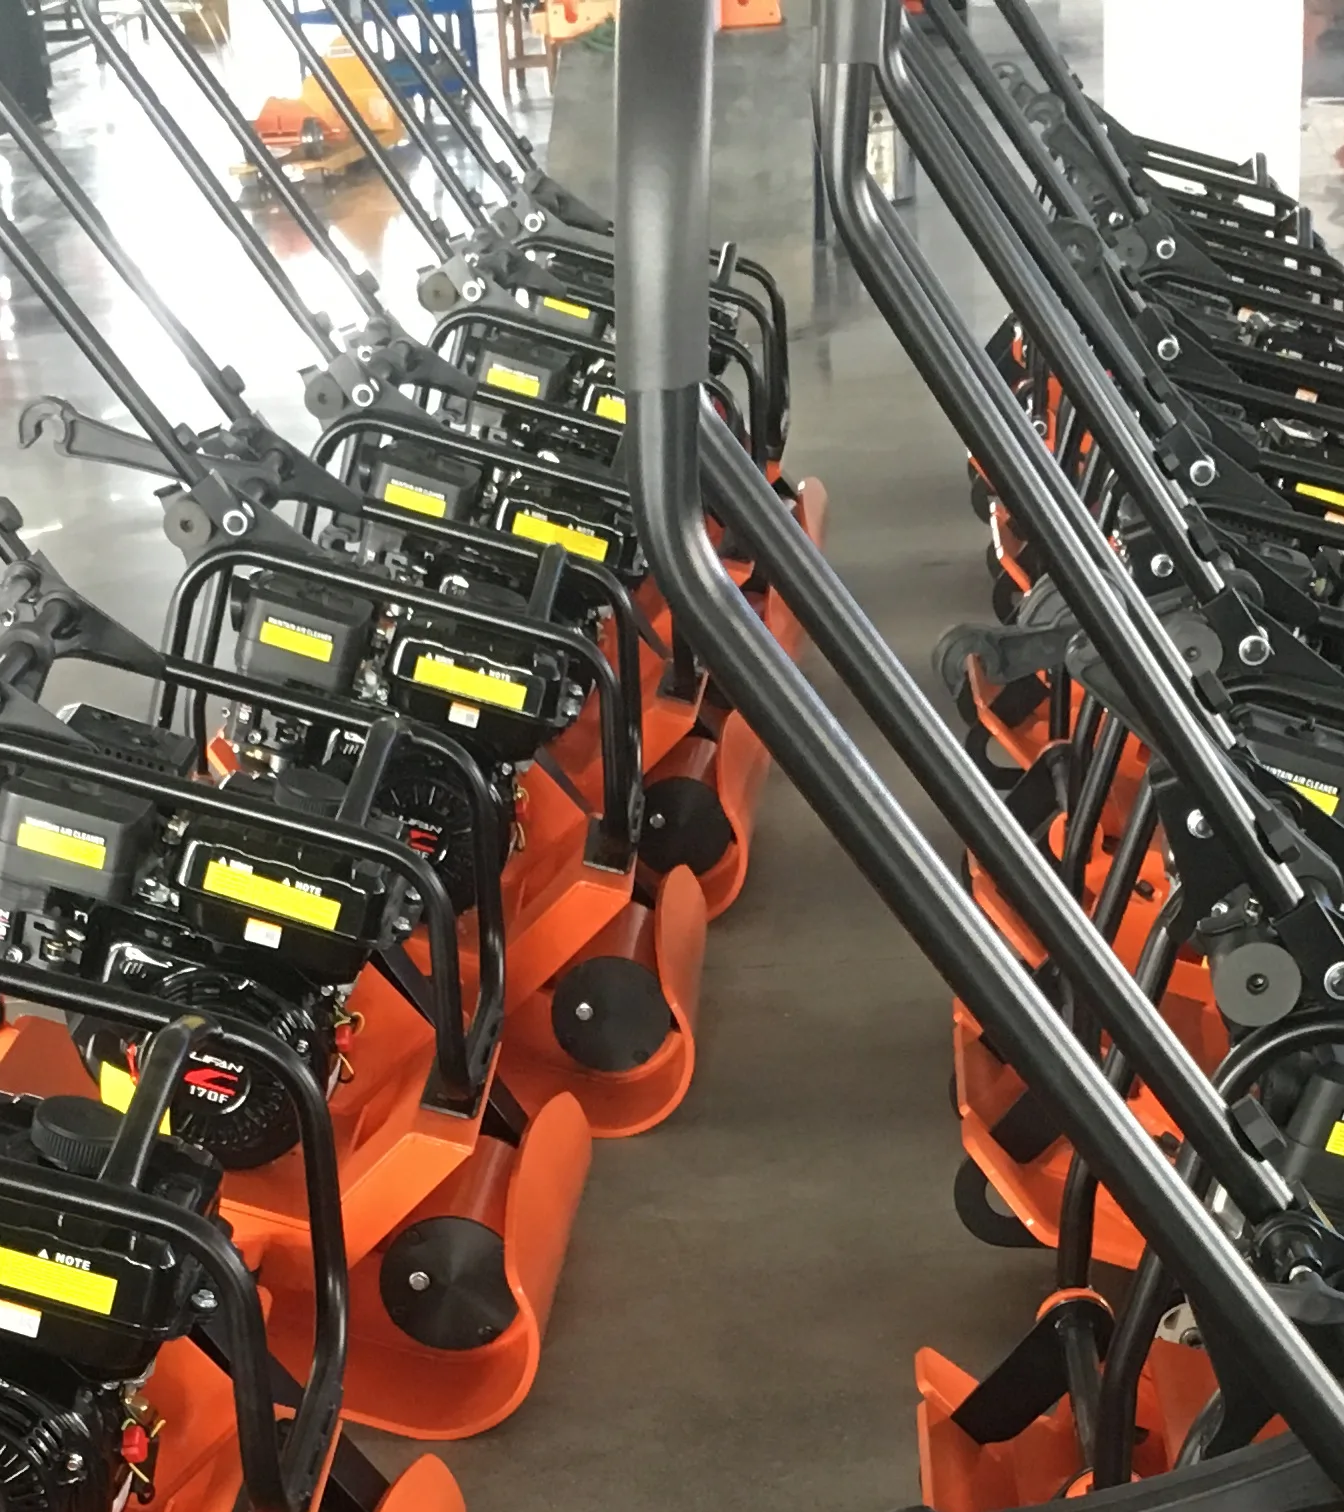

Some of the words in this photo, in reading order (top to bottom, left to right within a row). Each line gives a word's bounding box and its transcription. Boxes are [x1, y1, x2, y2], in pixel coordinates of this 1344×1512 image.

[1306, 778, 1338, 795] CLEANER
[295, 880, 323, 897] NOTE
[189, 1051, 244, 1073] LIFAN
[189, 1085, 230, 1104] 170F
[56, 1252, 91, 1271] NOTE
